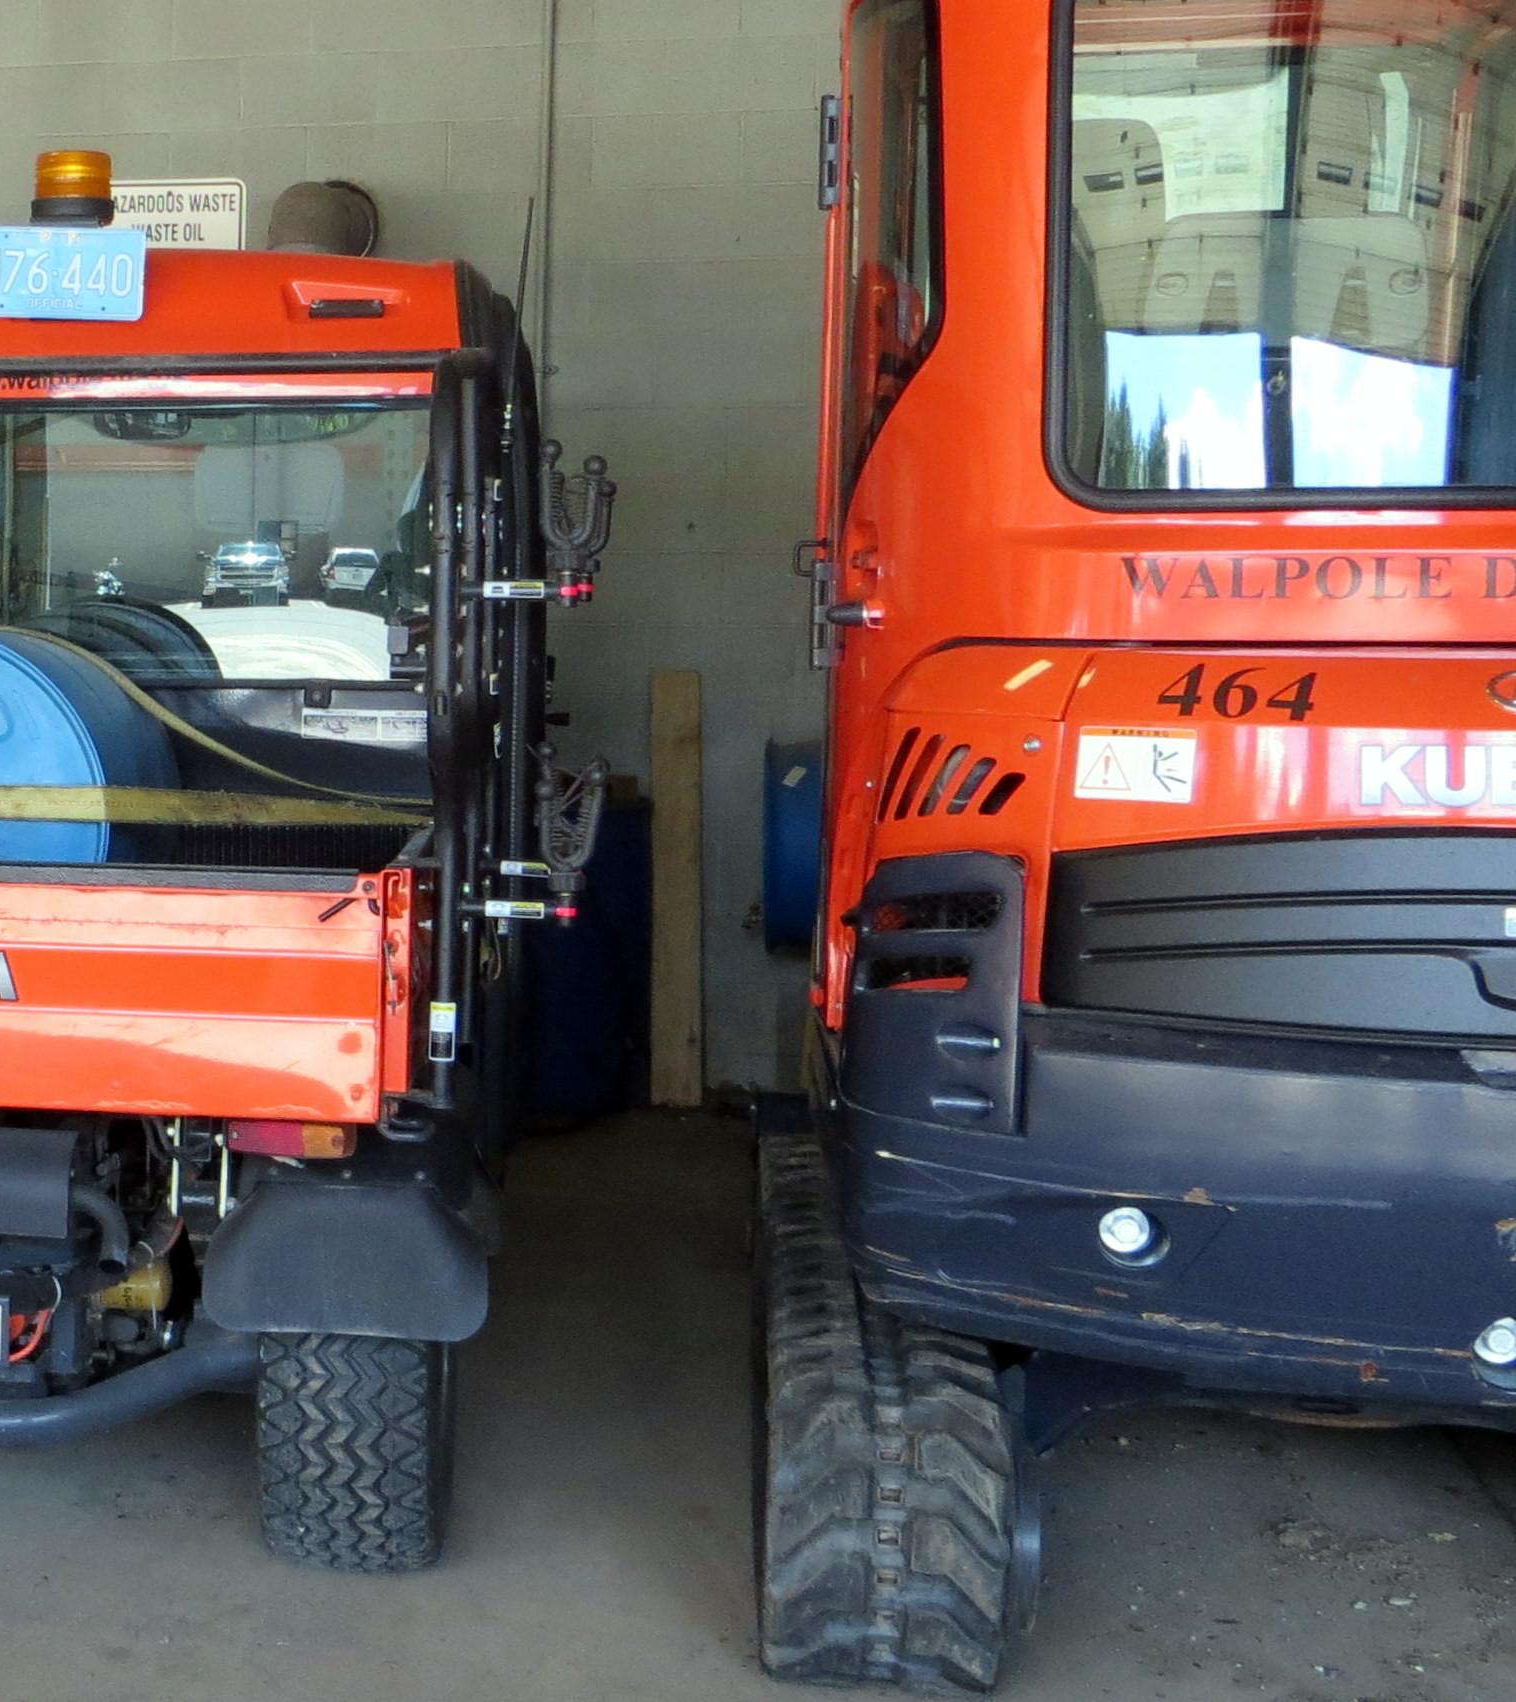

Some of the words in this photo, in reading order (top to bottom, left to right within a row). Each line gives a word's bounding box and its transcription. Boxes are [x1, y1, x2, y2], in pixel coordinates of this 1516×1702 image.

[113, 194, 184, 213] AZARDOUS
[189, 193, 236, 212] WASTE
[183, 223, 205, 241] OIL
[26, 296, 83, 310] OFFICIAL
[1121, 556, 1452, 600] WALPOLE
[1156, 663, 1318, 722] 464
[1112, 729, 1169, 738] WARNING
